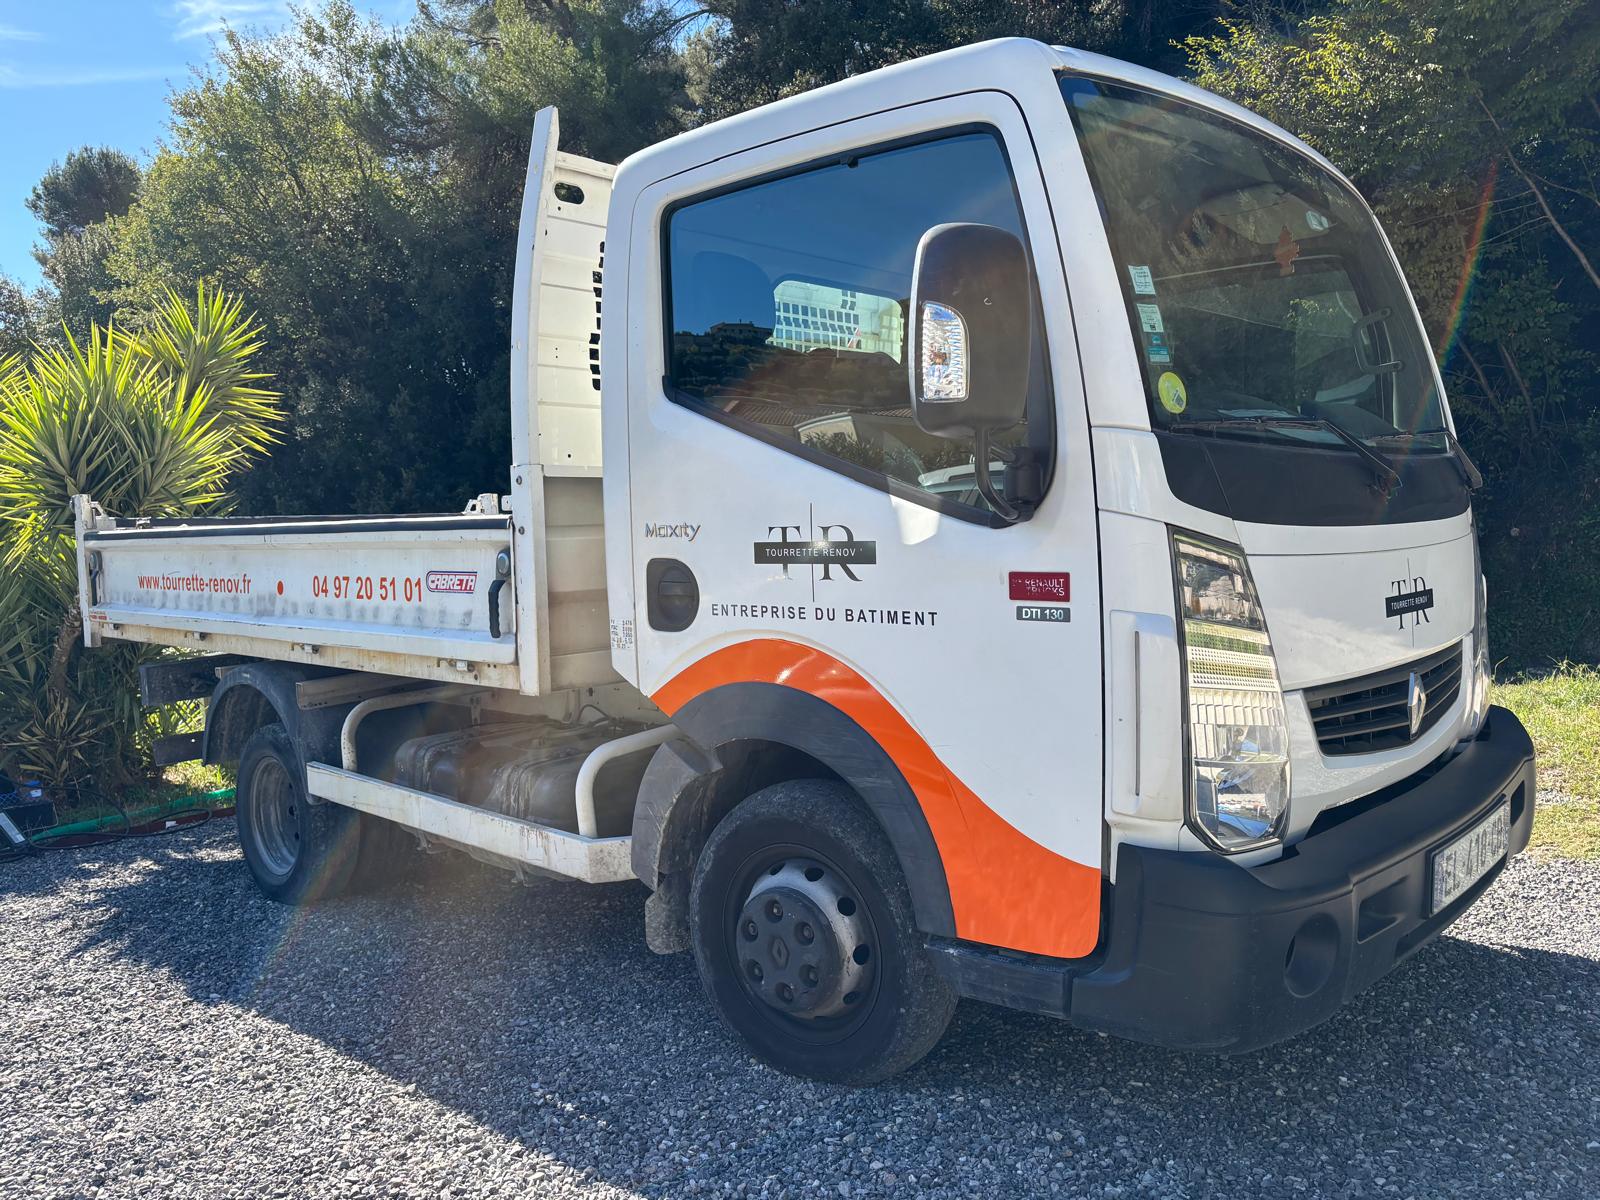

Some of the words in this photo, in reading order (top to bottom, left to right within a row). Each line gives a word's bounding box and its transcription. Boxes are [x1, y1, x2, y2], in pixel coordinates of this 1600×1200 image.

[645, 522, 701, 541] Maxity
[765, 548, 819, 557] TOURRETTE
[822, 547, 856, 557] RENOV
[138, 573, 252, 594] www.tourrette-renov.fr
[312, 575, 328, 597] 04
[333, 576, 350, 598] 97
[356, 577, 373, 600] 20
[379, 577, 396, 600] 51
[404, 577, 422, 602] 01
[429, 575, 476, 591] CABRETA
[1025, 578, 1065, 588] RENAULT
[1391, 600, 1415, 610] TOURRETTE
[711, 603, 807, 620] ENTREPRISE
[815, 607, 836, 621] DU
[845, 608, 938, 626] BATIMENT
[1022, 608, 1041, 619] DTI
[1044, 609, 1064, 620] 130
